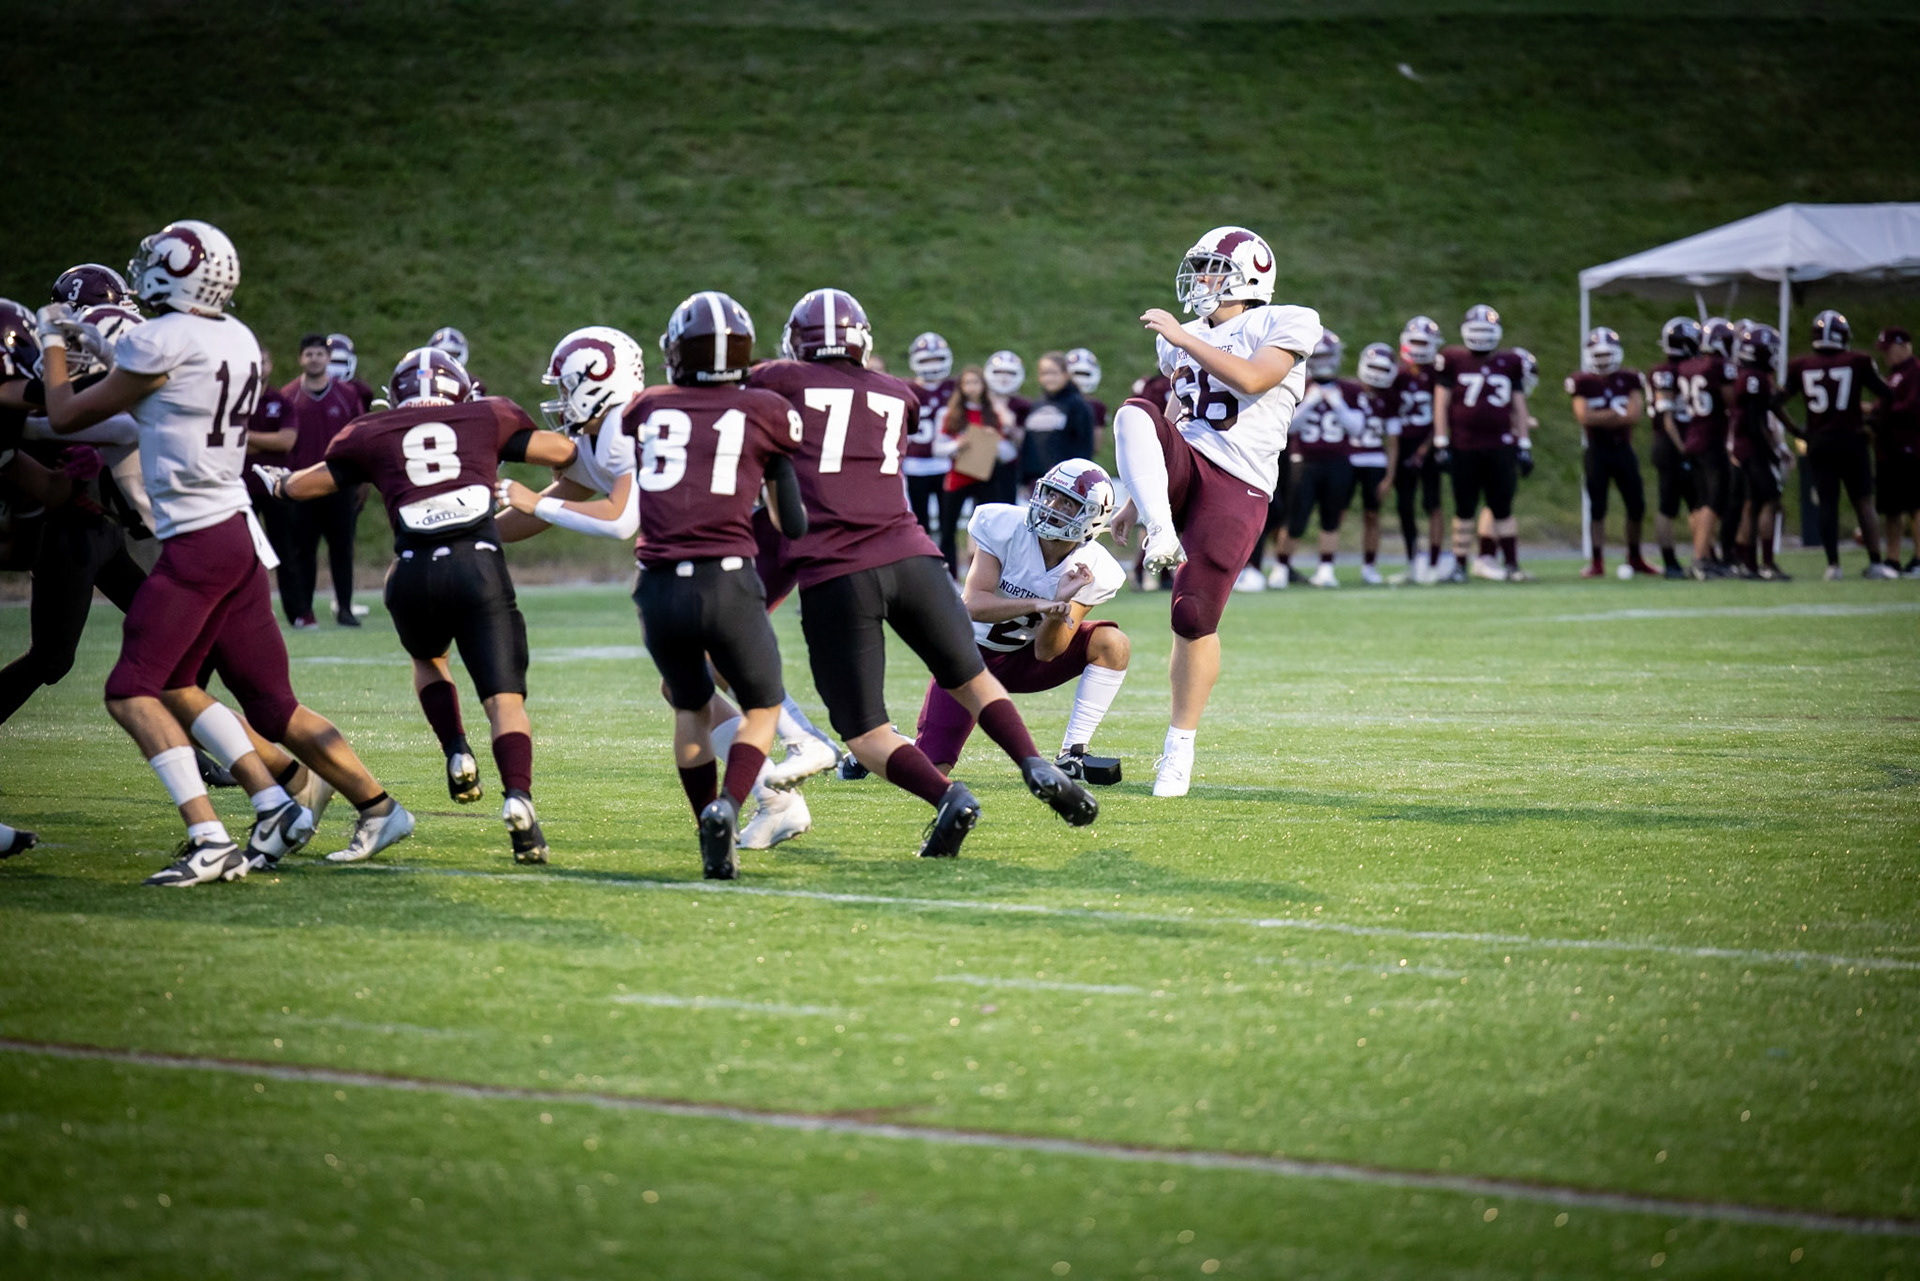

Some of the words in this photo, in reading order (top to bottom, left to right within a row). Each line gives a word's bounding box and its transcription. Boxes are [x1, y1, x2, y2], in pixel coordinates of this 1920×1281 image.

[68, 278, 84, 301] 3
[207, 361, 259, 449] 14
[1457, 373, 1512, 409] 73
[1801, 366, 1853, 414] 57
[638, 408, 747, 497] 81
[787, 408, 804, 443] 8
[803, 387, 906, 476] 77
[402, 421, 462, 488] 8
